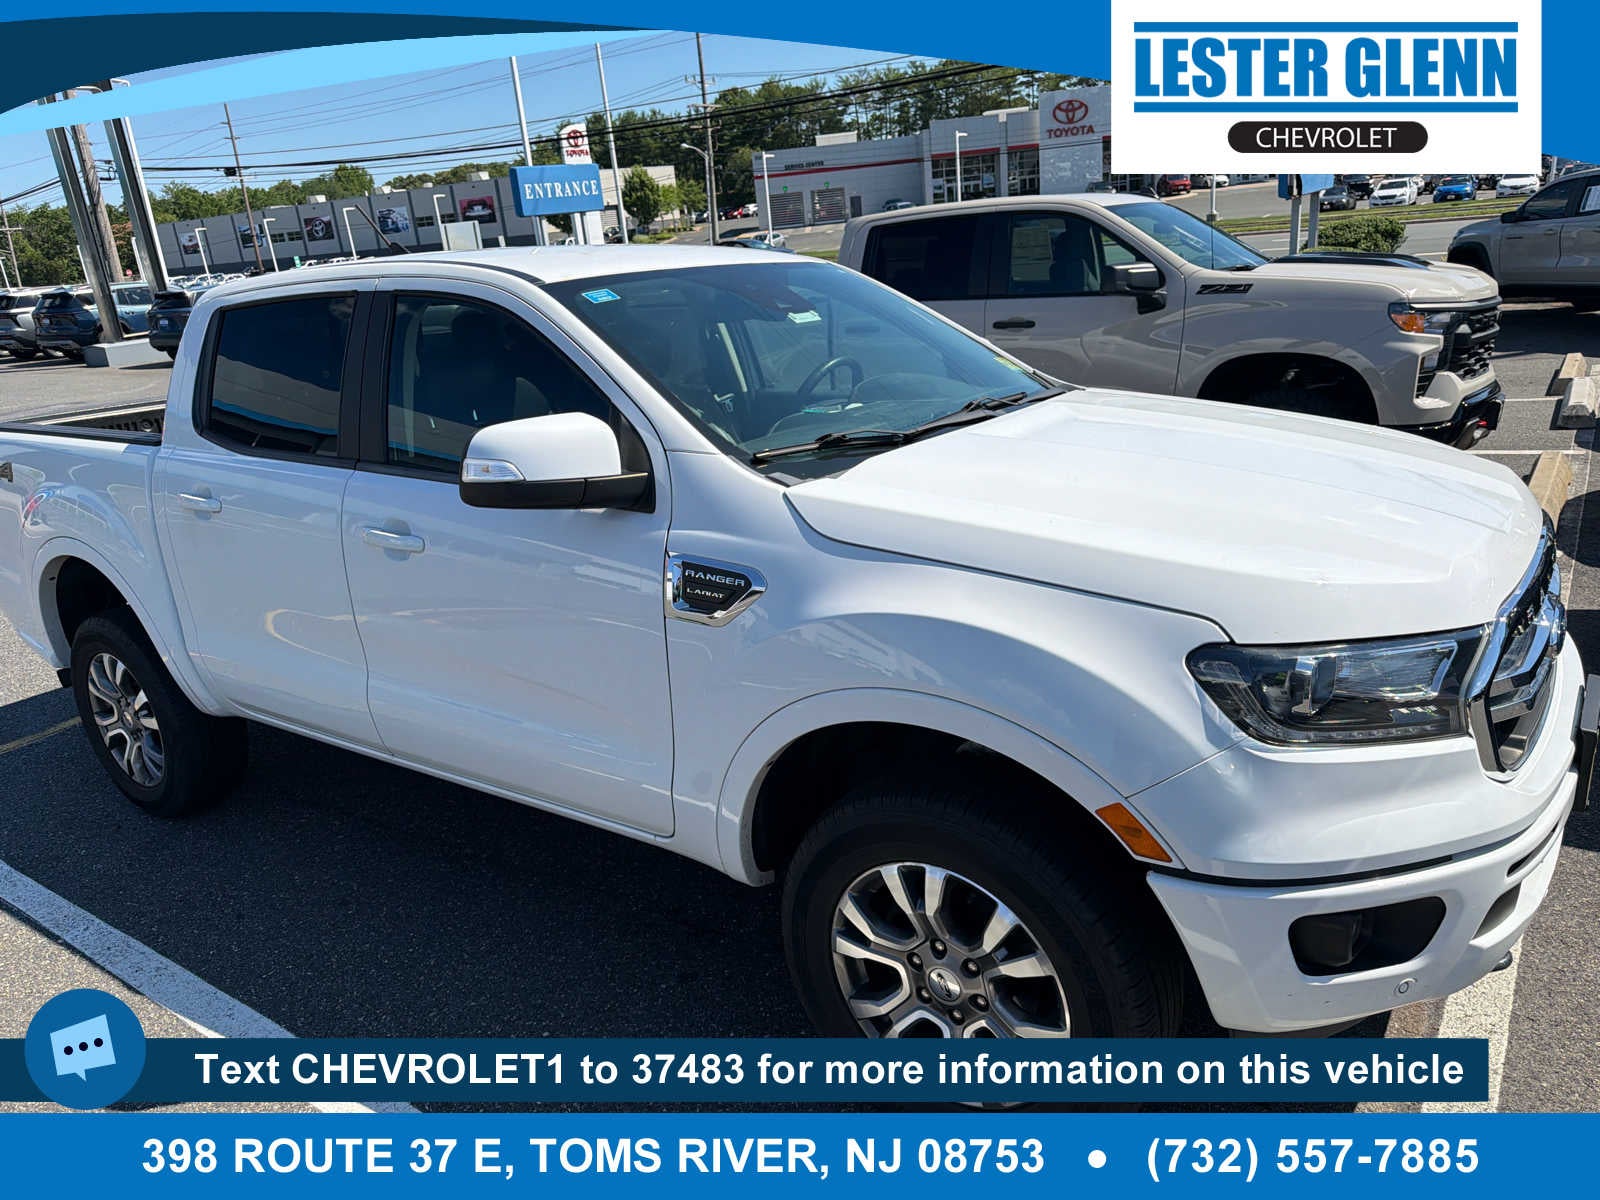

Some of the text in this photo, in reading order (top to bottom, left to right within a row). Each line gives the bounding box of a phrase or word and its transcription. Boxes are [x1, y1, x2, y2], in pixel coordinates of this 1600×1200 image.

[1046, 125, 1095, 139] TOYOTA
[565, 149, 589, 158] TOYOTA
[524, 179, 599, 200] ENTRANCE
[685, 569, 745, 587] RANGER
[686, 587, 725, 599] LARIAT
